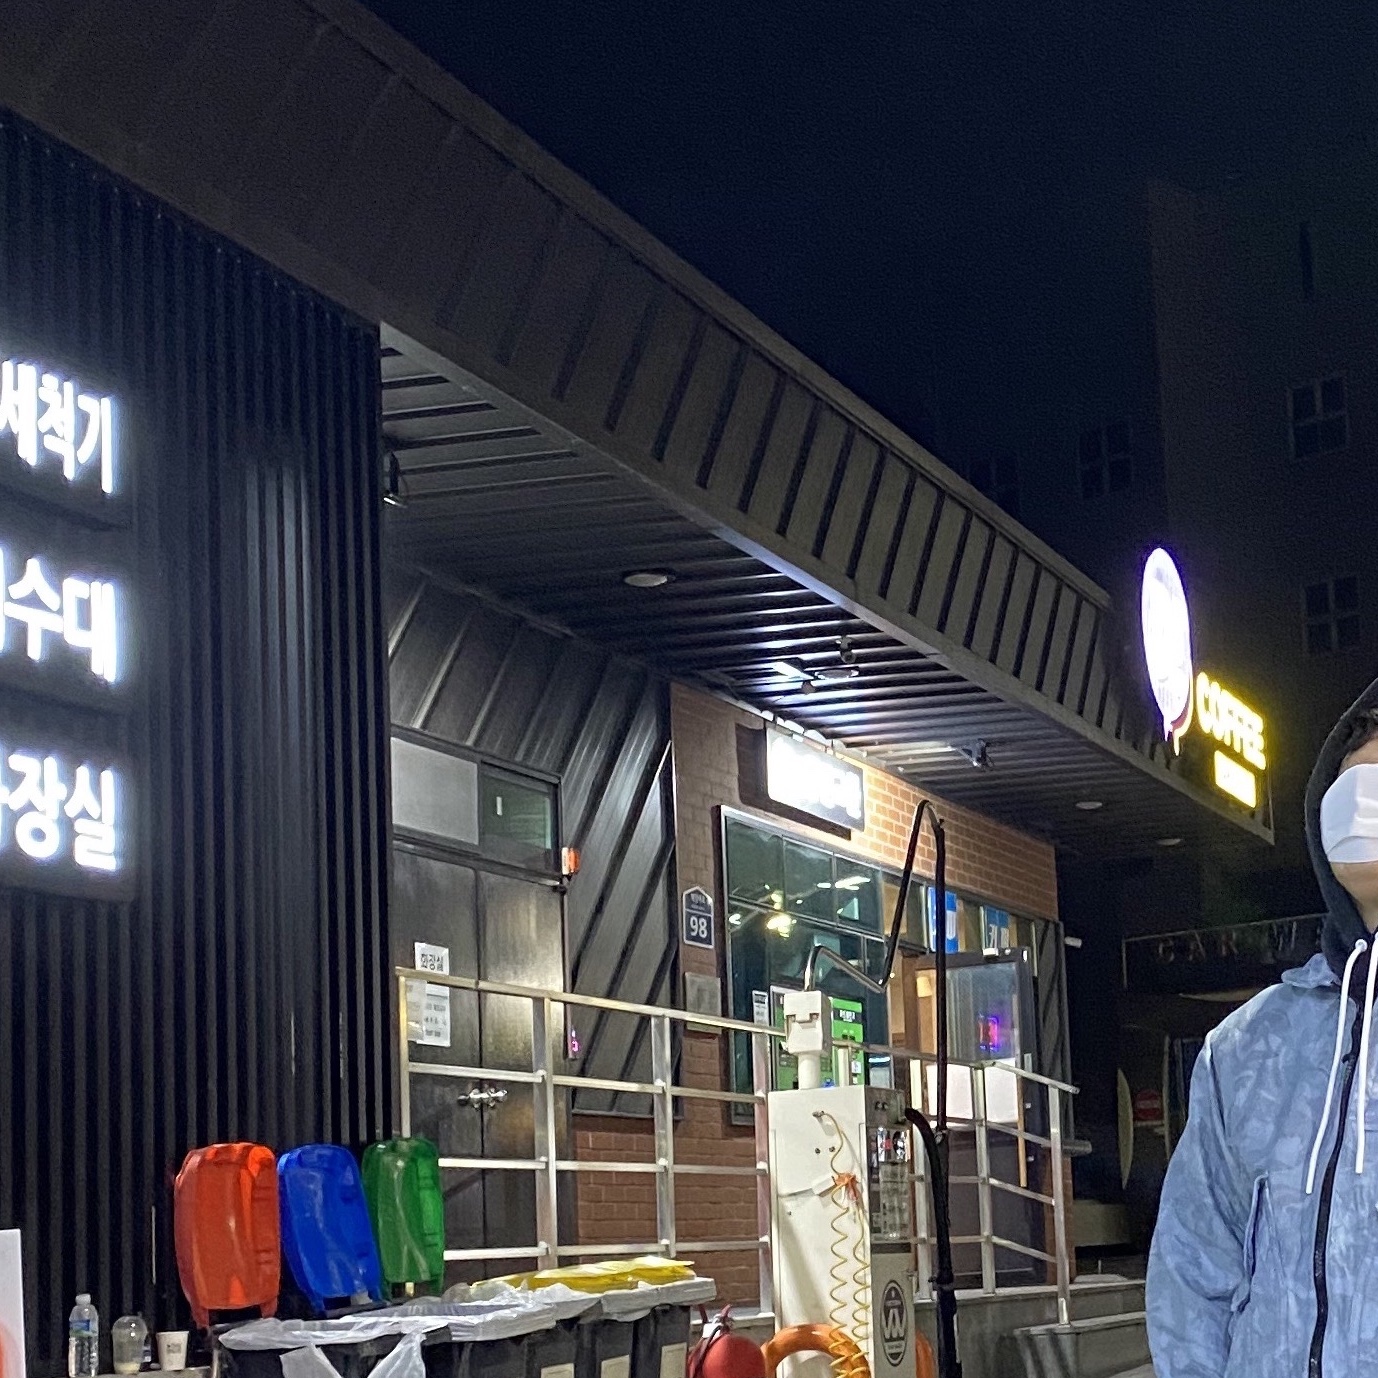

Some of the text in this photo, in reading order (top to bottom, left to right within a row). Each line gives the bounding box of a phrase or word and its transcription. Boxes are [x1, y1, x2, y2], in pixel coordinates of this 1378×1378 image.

[0, 546, 117, 683] 수대
[1196, 671, 1267, 771] COFFEE
[0, 752, 117, 871] 장실
[420, 952, 445, 973] 화장실
[689, 915, 708, 938] 98
